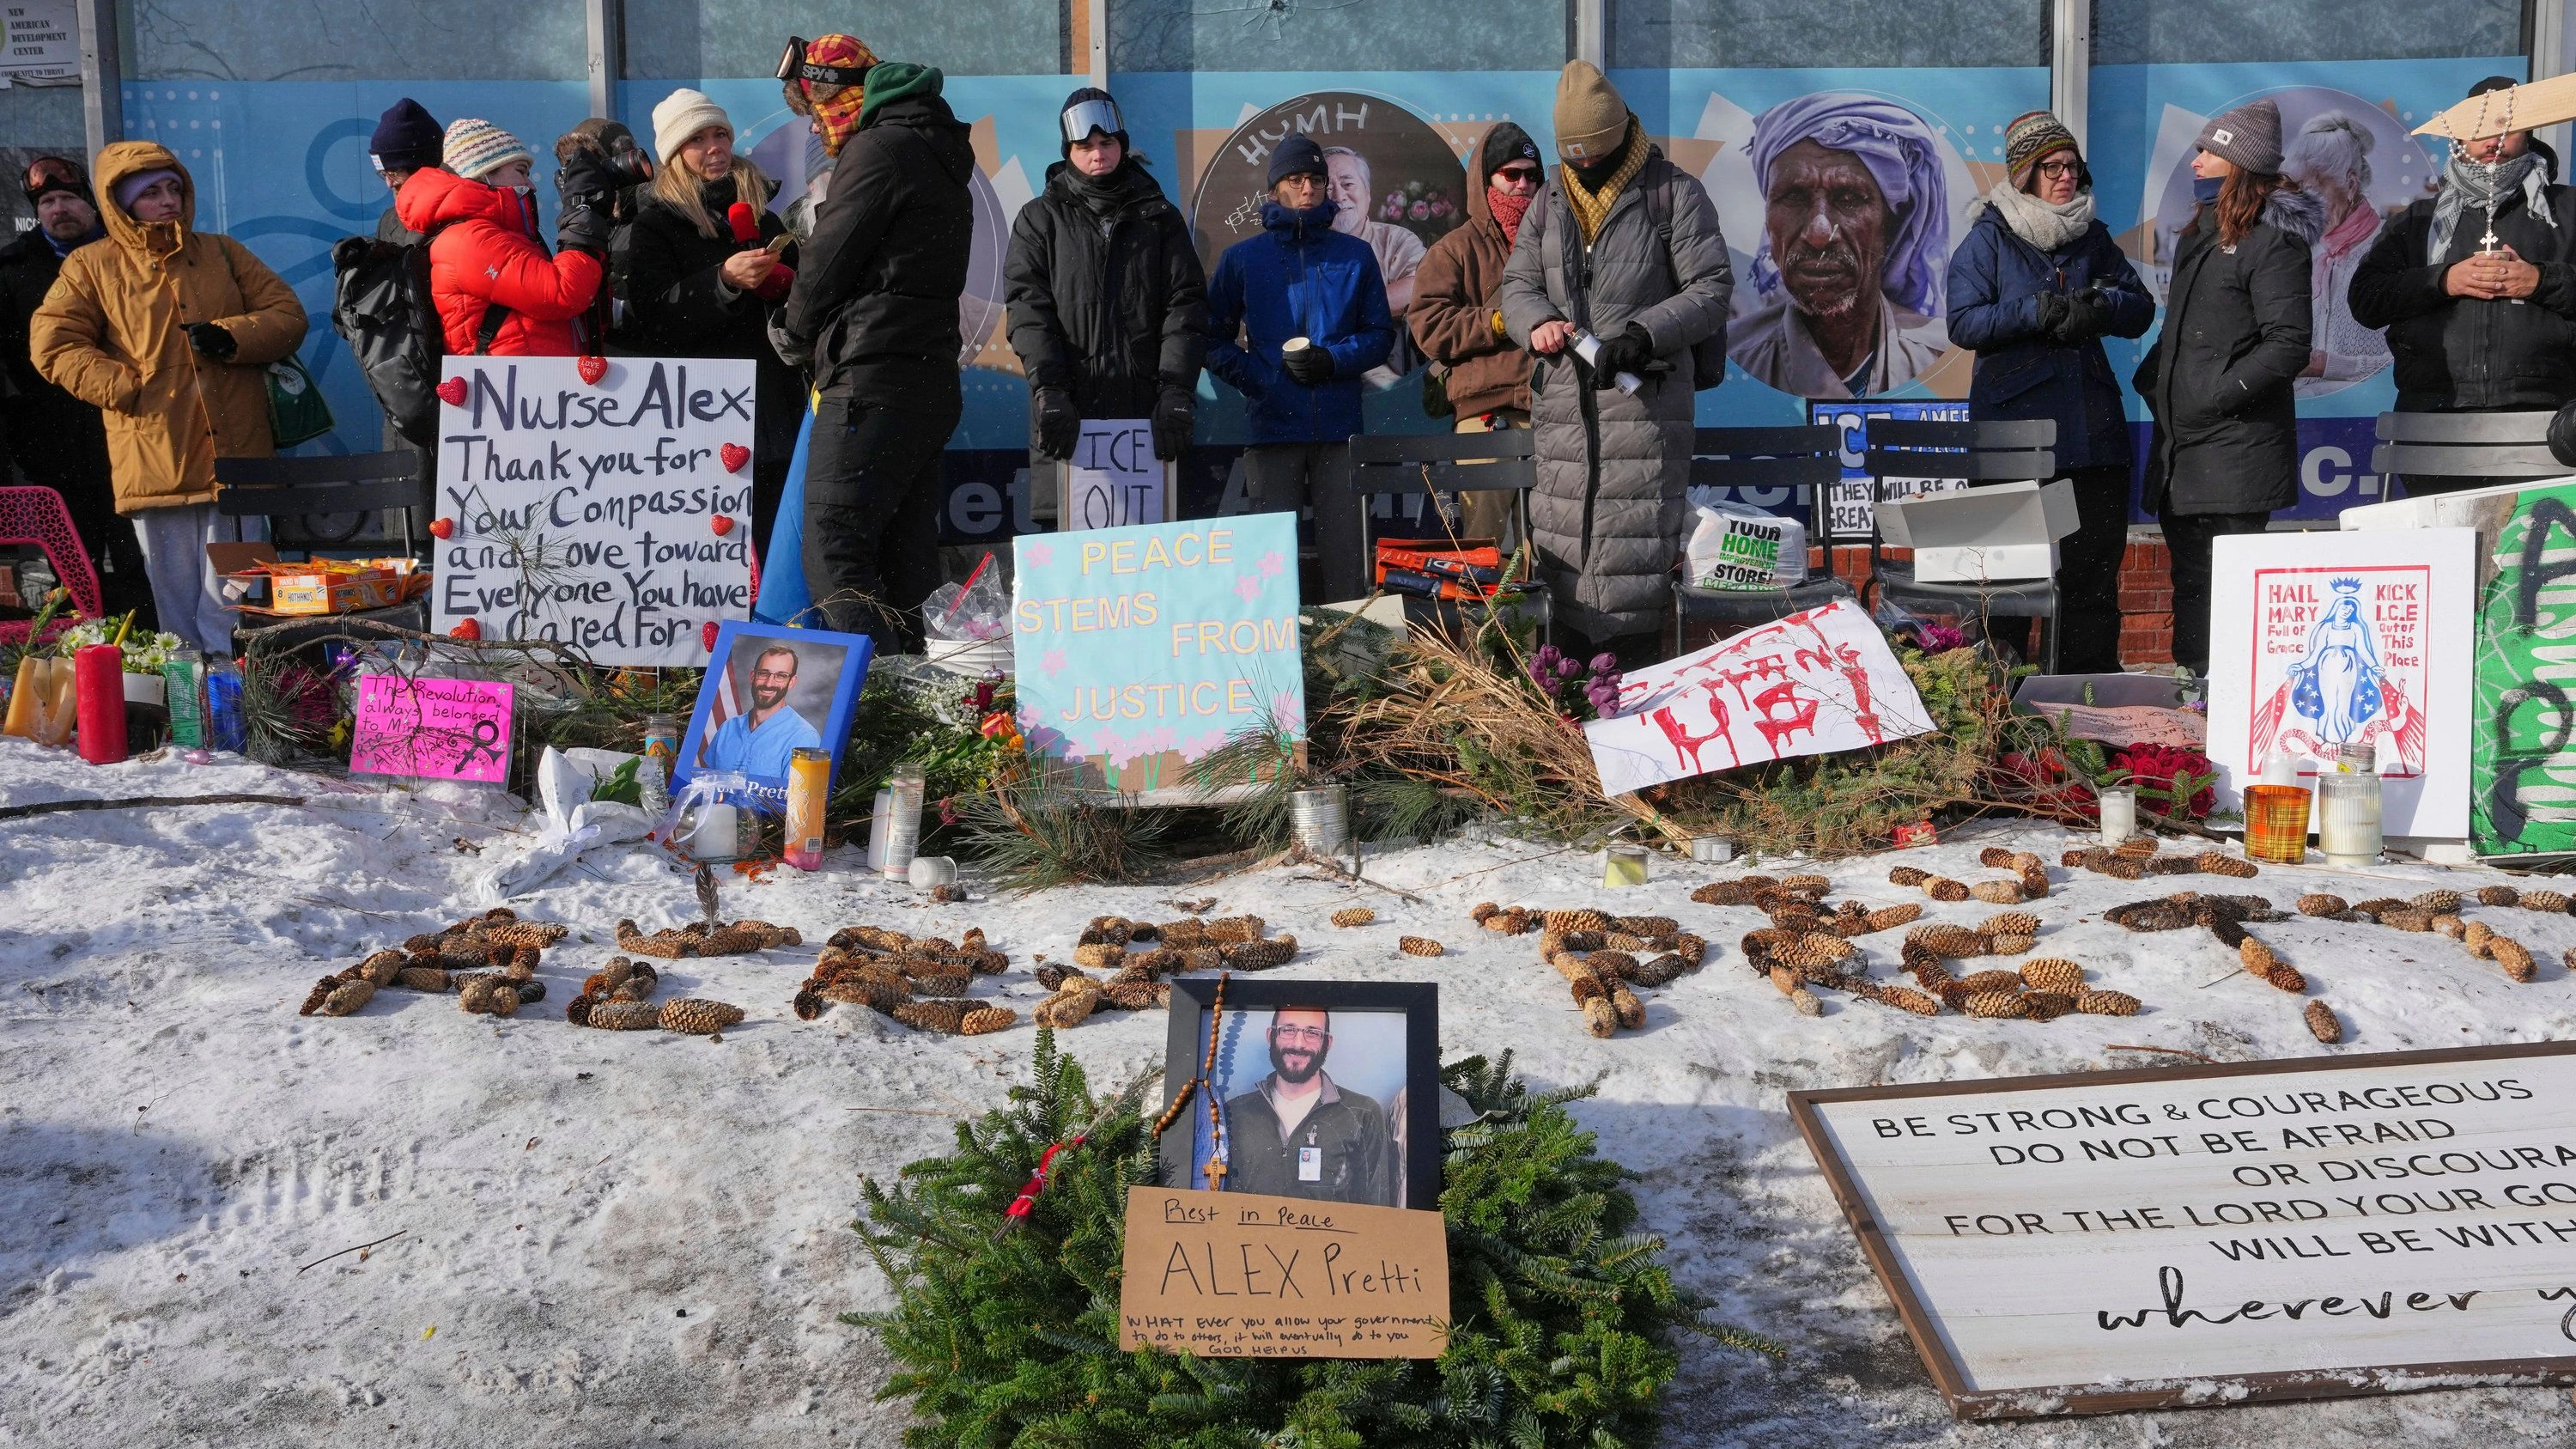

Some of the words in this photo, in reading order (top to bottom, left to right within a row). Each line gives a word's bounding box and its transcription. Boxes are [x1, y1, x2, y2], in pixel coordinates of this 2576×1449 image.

[8, 9, 25, 17] NEW
[10, 20, 51, 30] AMERICAN
[11, 32, 67, 43] DEVELOPMENT
[13, 46, 44, 56] CENTER
[580, 361, 600, 369] LOVE
[472, 364, 629, 430] Nurse
[444, 435, 572, 483] Thank
[578, 448, 644, 490] you
[644, 436, 712, 476] for
[1082, 429, 1150, 473] ICE
[1832, 482, 1874, 502] THEY
[446, 484, 538, 539] Your
[550, 484, 752, 530] Compassion
[1084, 484, 1153, 531] OUT
[447, 534, 519, 570] and
[634, 525, 750, 569] toward
[1081, 529, 1234, 576] PEACE
[1721, 533, 1780, 562] HOME
[443, 573, 617, 619] Everyone
[622, 569, 676, 608] You
[683, 569, 749, 609] have
[2269, 584, 2319, 603] HAIL
[2375, 584, 2417, 601] KICK
[634, 605, 692, 648] For
[1017, 591, 1159, 634] STEMS
[2269, 606, 2318, 624] MARY
[1170, 615, 1298, 658] FROM
[2267, 640, 2304, 654] Grace
[2381, 634, 2414, 650] This
[2384, 651, 2420, 667] Place
[366, 677, 406, 698] The
[1060, 678, 1255, 721] JUSTICE
[362, 716, 379, 731] to
[365, 700, 421, 719] always
[433, 703, 500, 727] belonged
[1872, 1117, 1936, 1138] BE
[1947, 1103, 2151, 1135] STRONG
[2162, 1104, 2190, 1121] &
[2197, 1079, 2534, 1120] COURAGEOUS
[1989, 1143, 2064, 1166] DO
[2079, 1135, 2180, 1161] NOT
[2200, 1130, 2268, 1154] BE
[2281, 1118, 2456, 1149] AFRAID
[2233, 1163, 2311, 1187] OR
[1164, 1198, 1219, 1222] Rest
[1239, 1206, 1260, 1221] in
[1278, 1206, 1334, 1227] Peace
[1944, 1213, 2054, 1237] FOR
[2062, 1207, 2175, 1233] THE
[2182, 1199, 2329, 1227] LORD
[2336, 1188, 2496, 1216] YOUR
[2208, 1234, 2351, 1262] WILL
[2358, 1229, 2434, 1255] BE
[2435, 1219, 2576, 1249] WITH
[1160, 1241, 1303, 1299] ALEX
[1323, 1242, 1422, 1296] Pretti
[2097, 1265, 2483, 1331] wherever
[1242, 1318, 1266, 1331] you
[1274, 1316, 1310, 1327] allow
[1318, 1318, 1346, 1332] your
[1354, 1316, 1434, 1330] government
[1132, 1331, 1148, 1342] to
[1155, 1332, 1169, 1341] do
[1174, 1332, 1186, 1342] to
[1234, 1332, 1249, 1342] it
[1252, 1330, 1273, 1342] will
[1279, 1330, 1342, 1348] eventually
[1352, 1331, 1363, 1341] do
[1370, 1331, 1382, 1341] to
[1387, 1332, 1409, 1343] you
[1208, 1345, 1242, 1355] GOD
